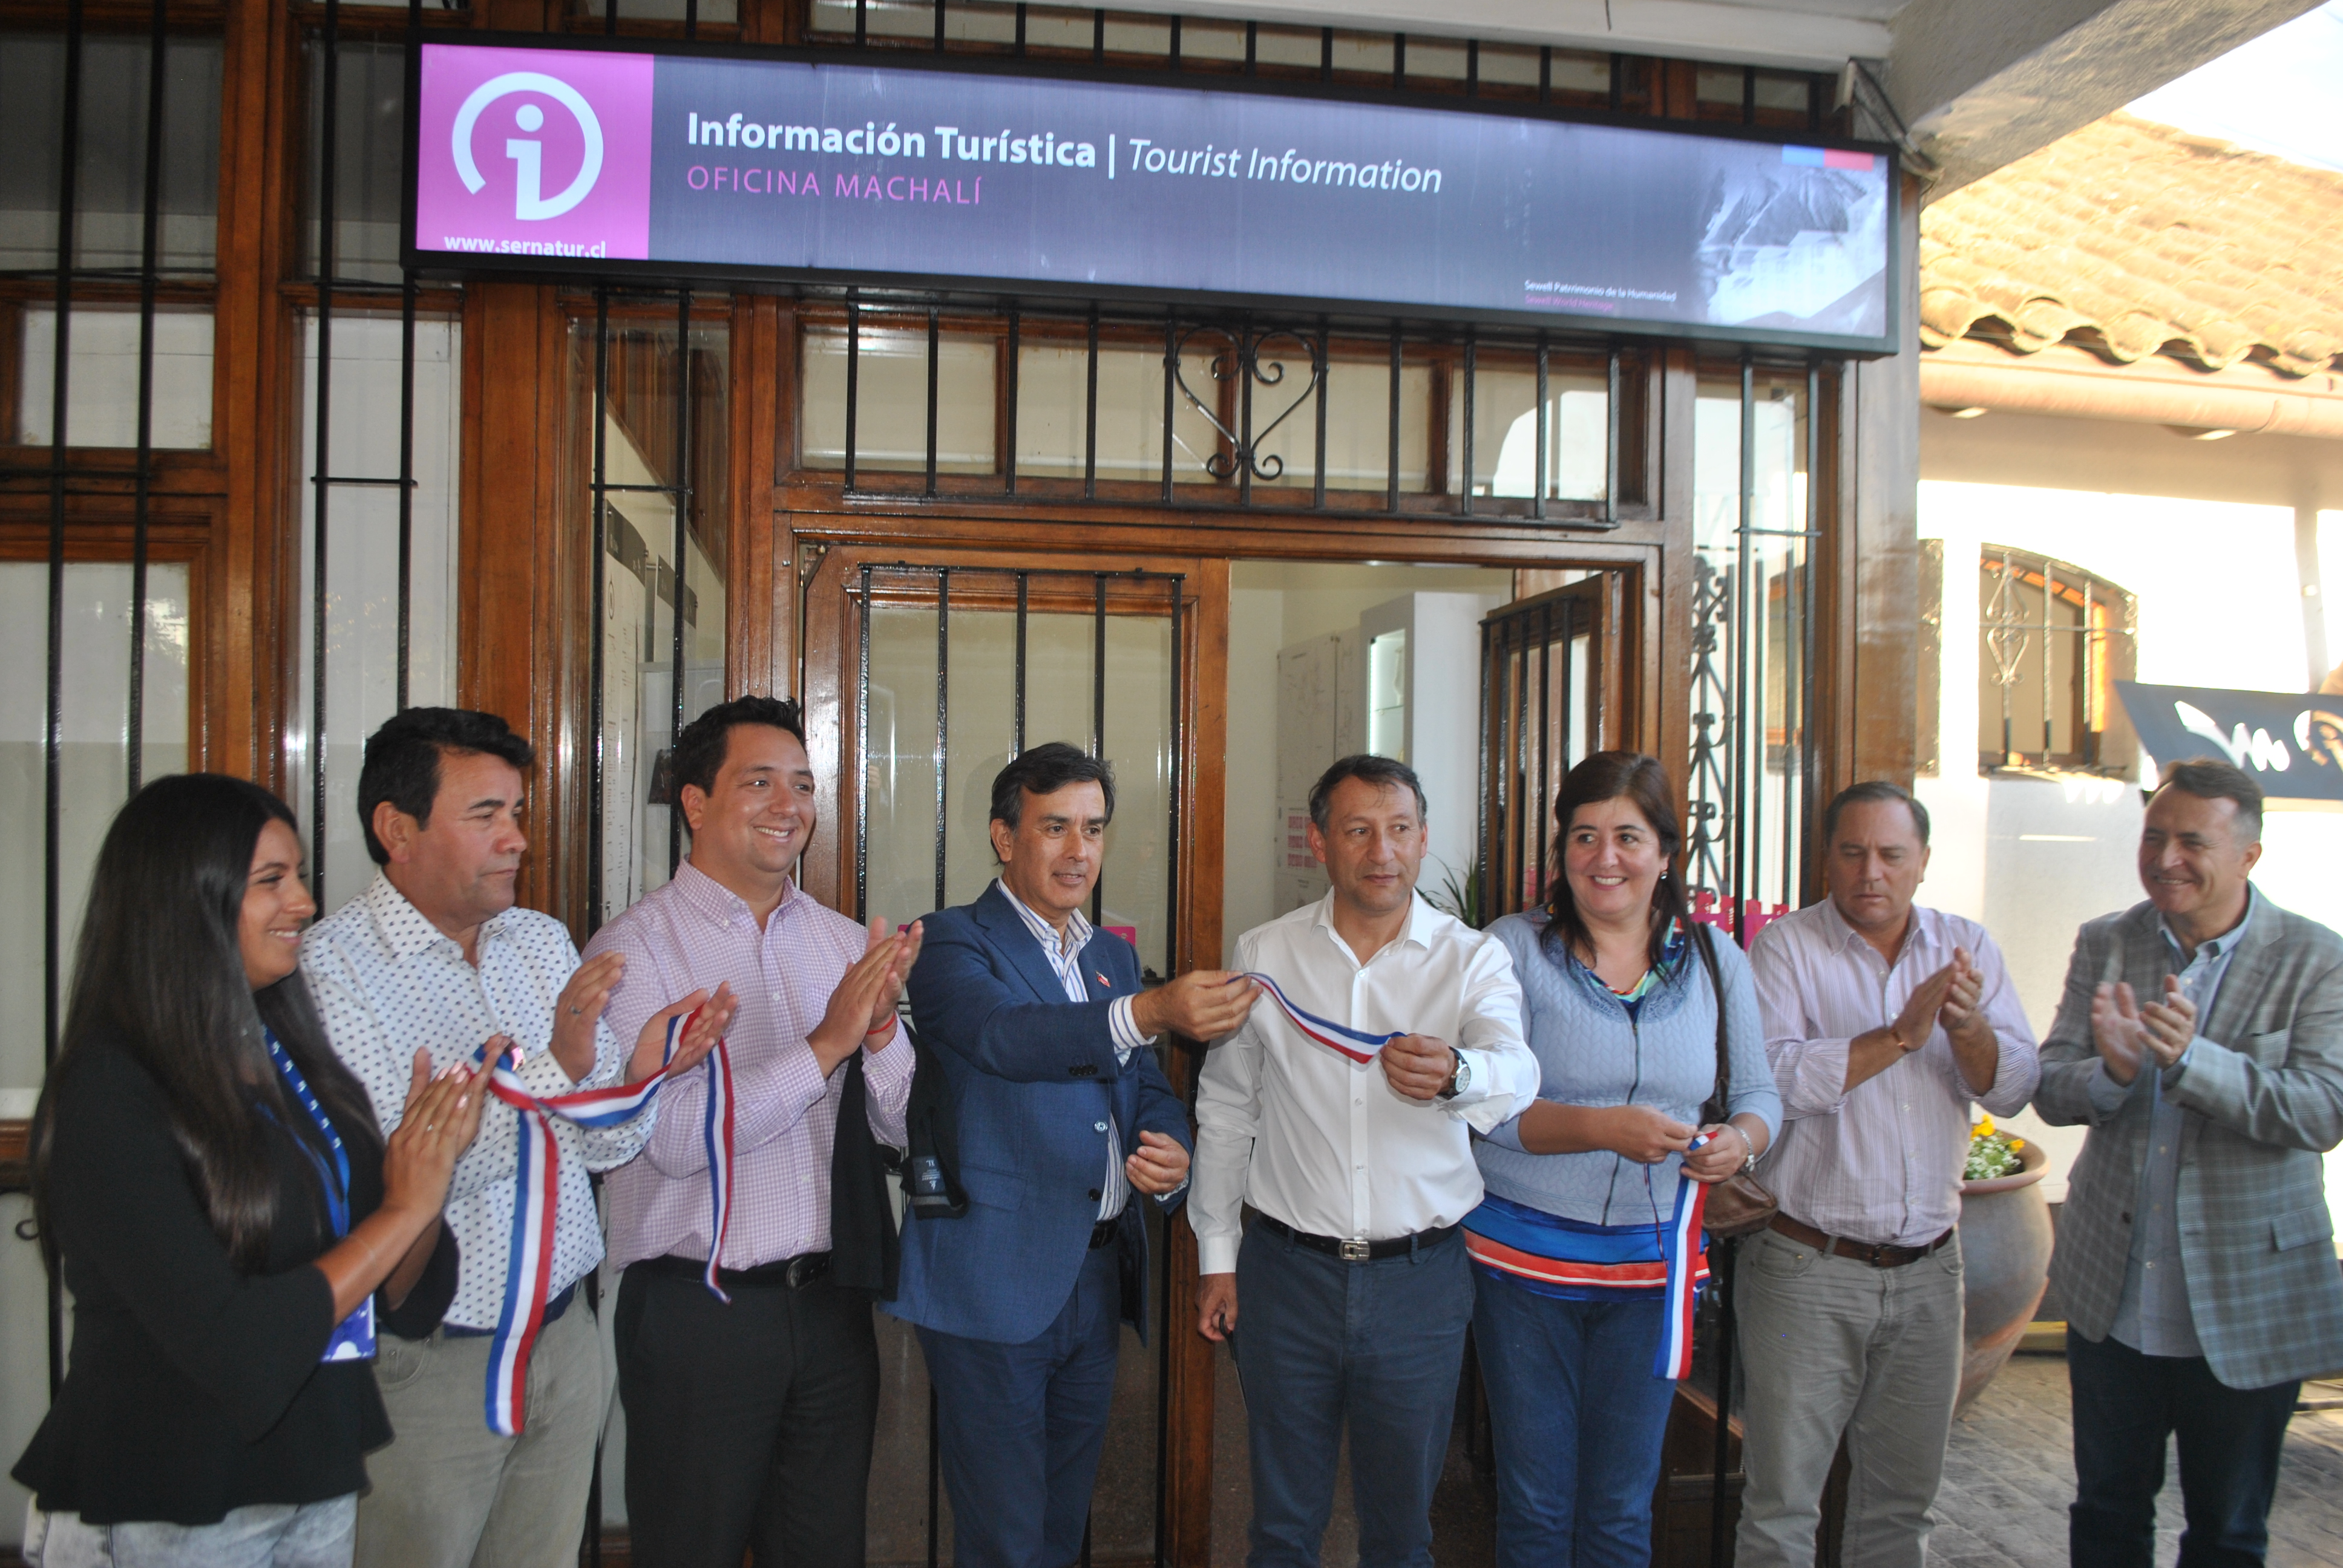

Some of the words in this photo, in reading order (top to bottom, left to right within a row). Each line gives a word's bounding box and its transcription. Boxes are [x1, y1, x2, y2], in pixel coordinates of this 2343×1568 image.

[688, 112, 925, 158] Información
[935, 125, 1095, 168] Turística
[1129, 139, 1240, 178] Tourist
[1247, 148, 1442, 193] Information
[687, 165, 820, 196] OFICINA
[835, 174, 982, 204] MACHALÍ
[444, 237, 606, 258] www.sernatur.cl
[1524, 279, 1553, 292] Sewell
[1554, 281, 1605, 296] Patrimonio
[1605, 286, 1617, 298] de
[1618, 287, 1627, 298] la
[1627, 288, 1677, 302] Humanidad
